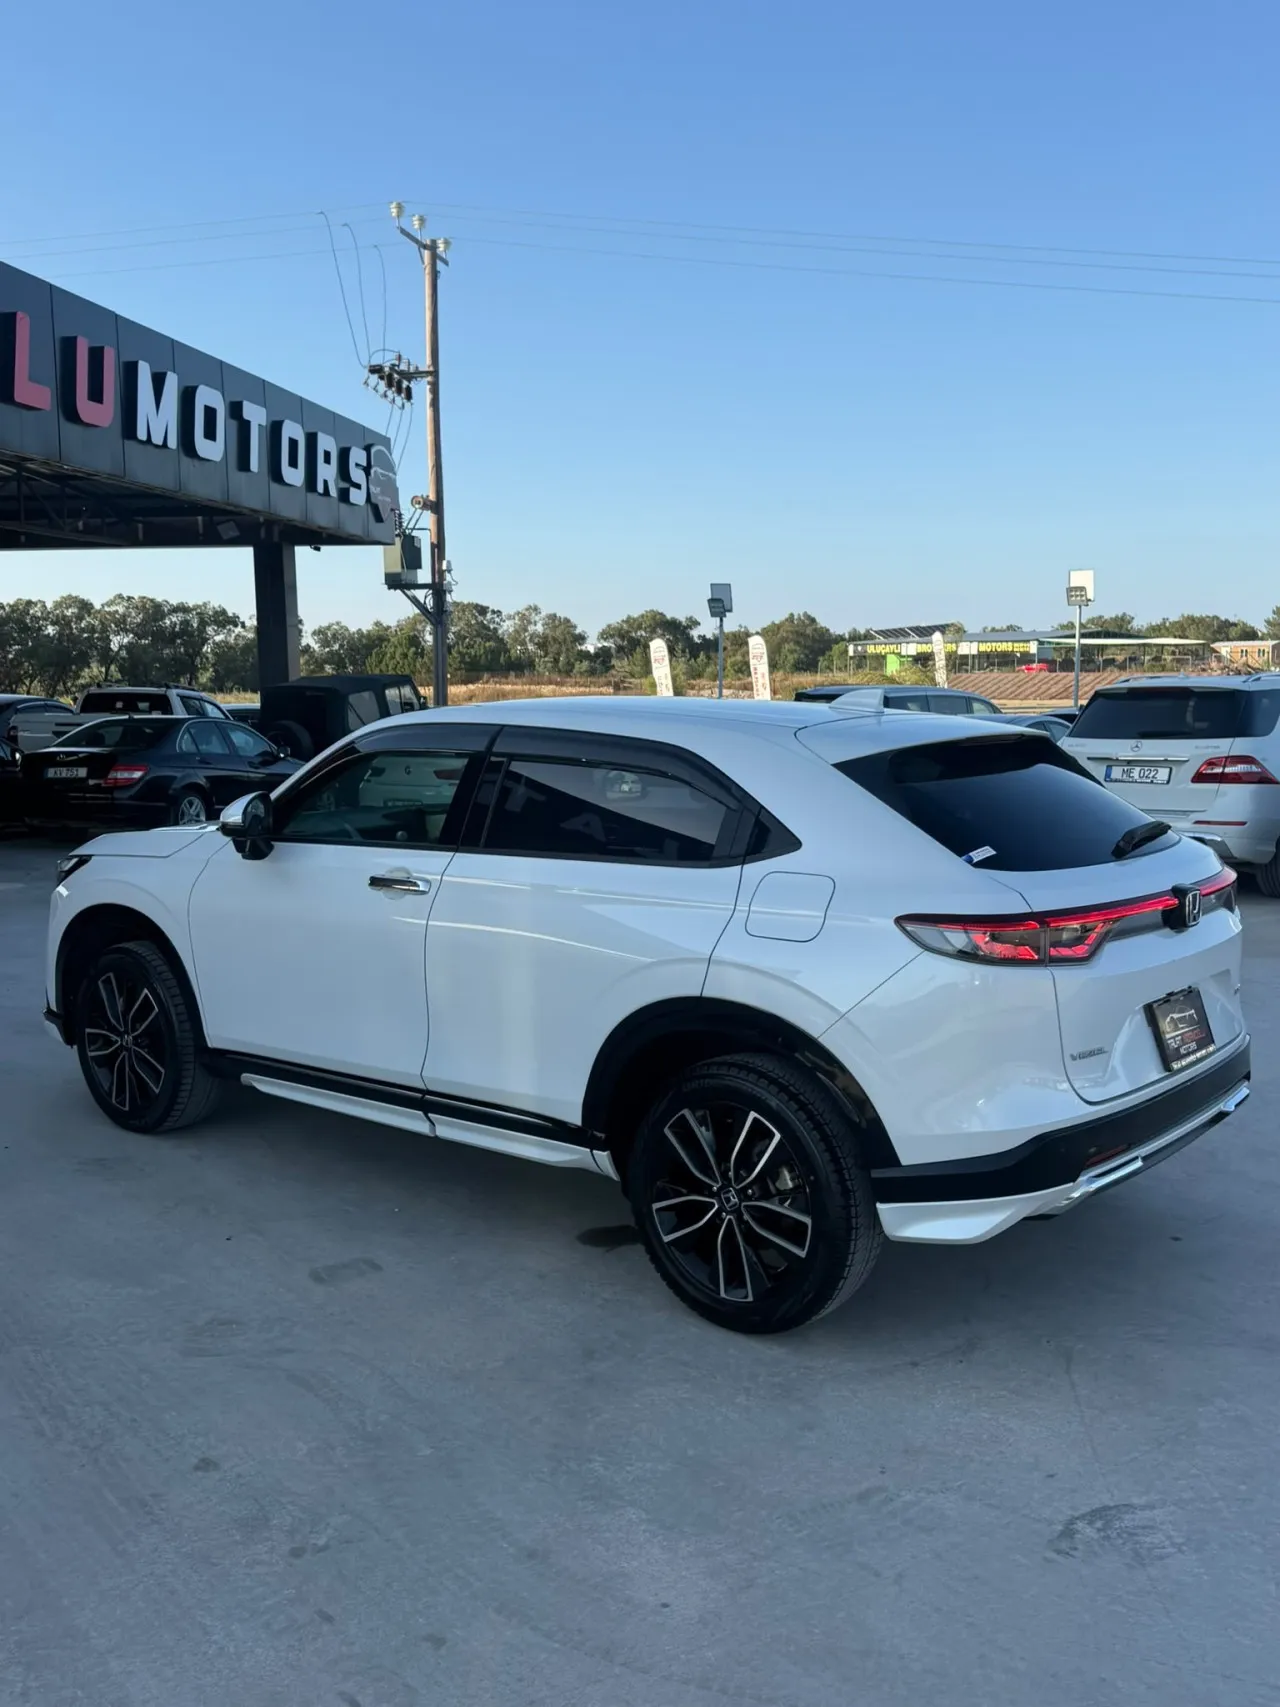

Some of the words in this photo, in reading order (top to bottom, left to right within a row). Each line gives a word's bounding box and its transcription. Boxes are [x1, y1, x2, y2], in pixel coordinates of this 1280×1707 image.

[136, 360, 368, 505] MOTORS
[916, 643, 957, 653] BROERS
[978, 642, 1013, 652] MOTORS
[1121, 767, 1135, 779] ME
[1138, 768, 1159, 780] 022
